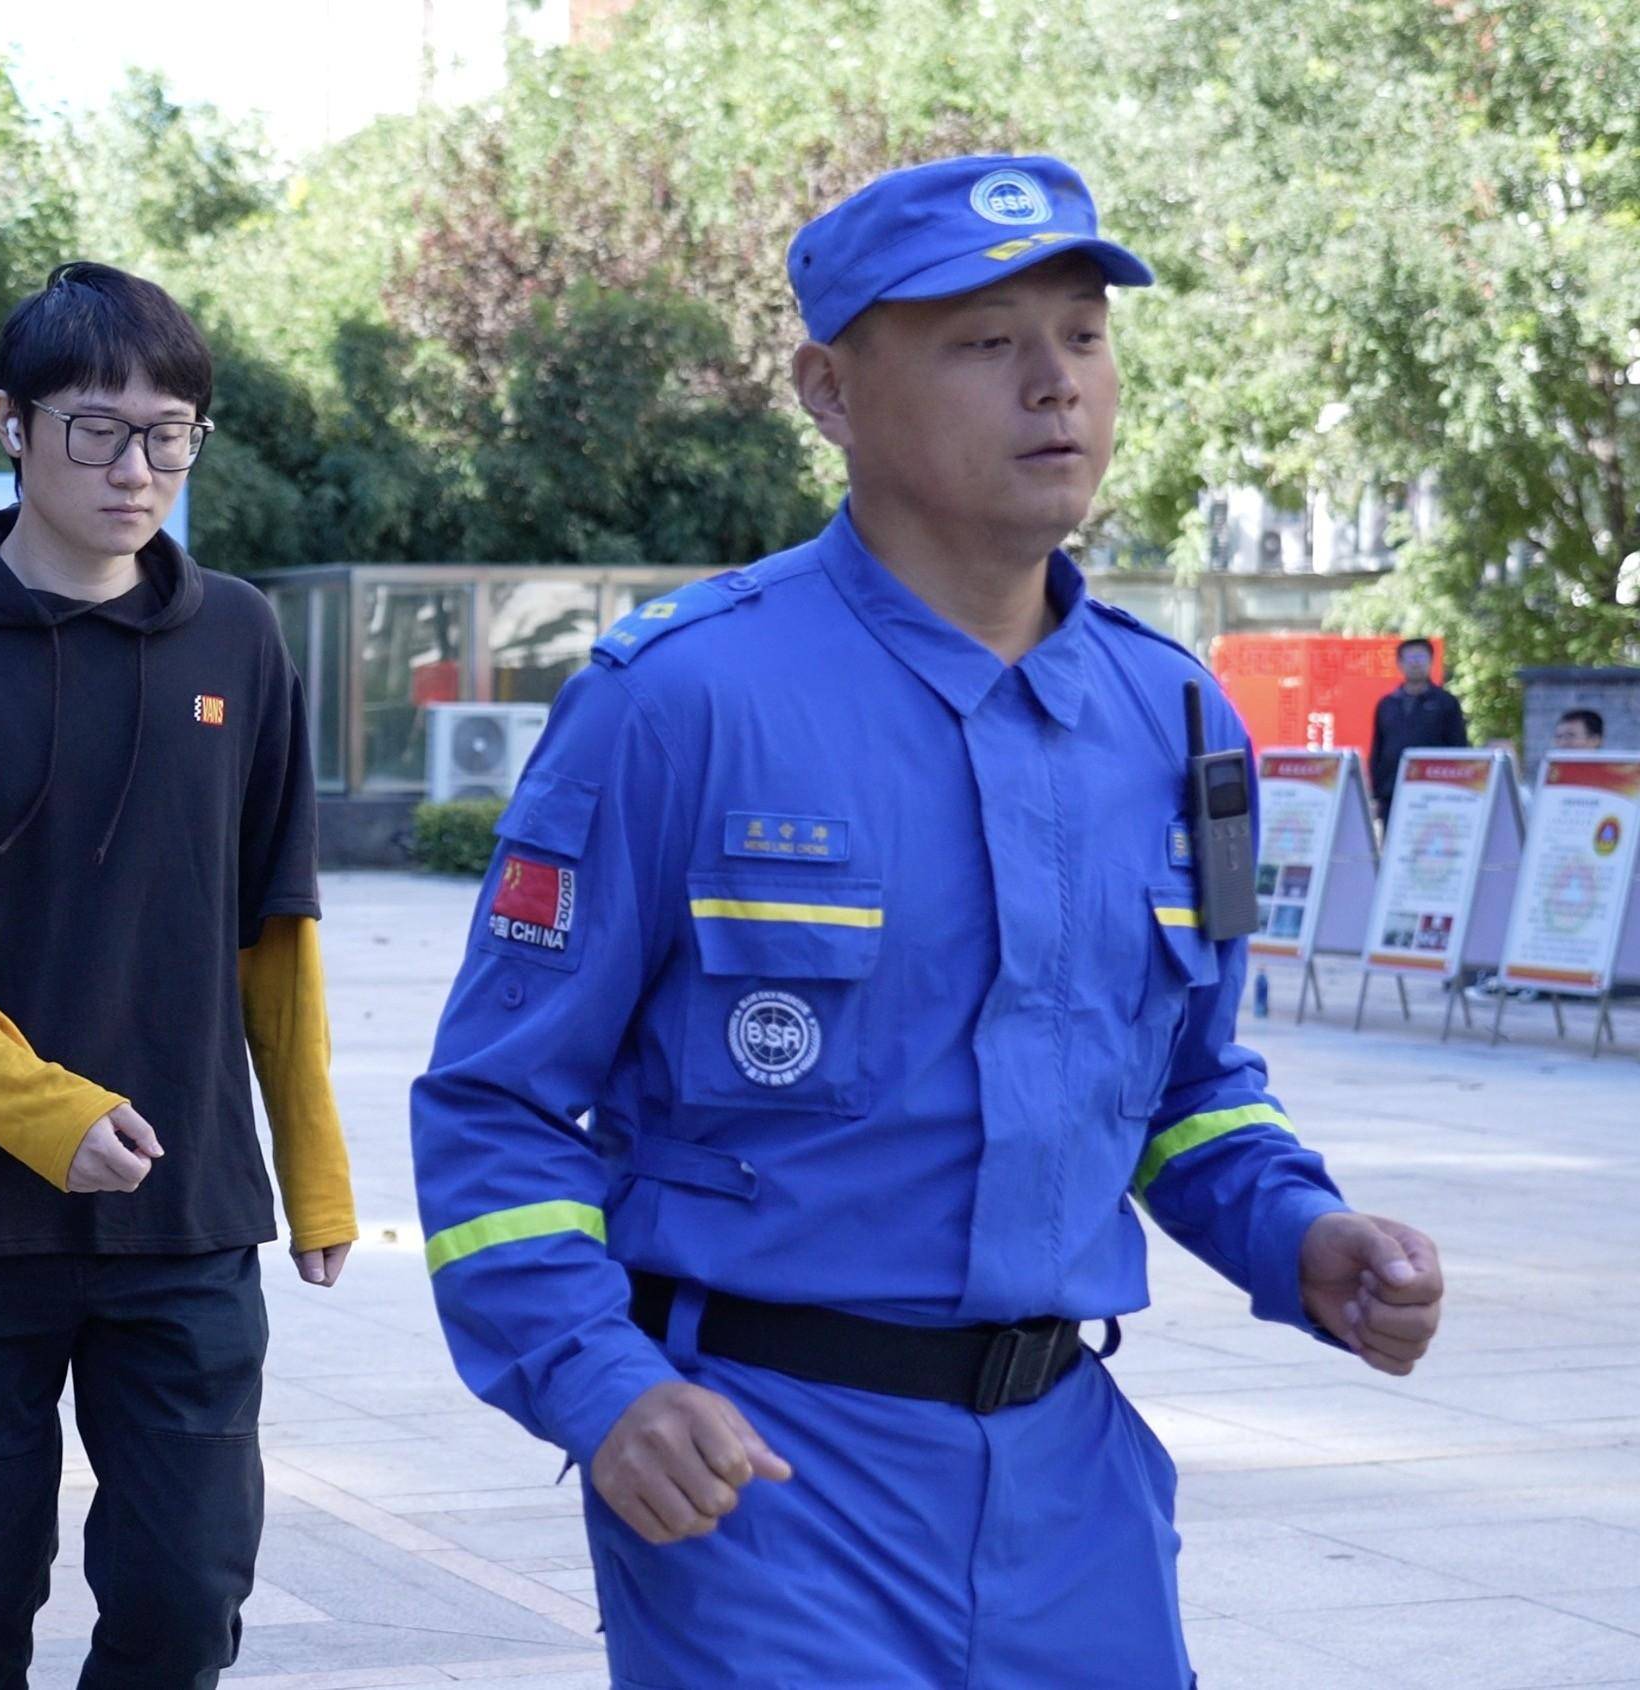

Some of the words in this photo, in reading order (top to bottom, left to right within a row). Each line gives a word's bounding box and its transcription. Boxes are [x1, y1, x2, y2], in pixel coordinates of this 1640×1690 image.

[989, 194, 1034, 212] BSR
[202, 695, 224, 725] VANS
[559, 871, 572, 929] BSR
[511, 920, 565, 950] CHINA
[746, 1020, 801, 1051] BSR
